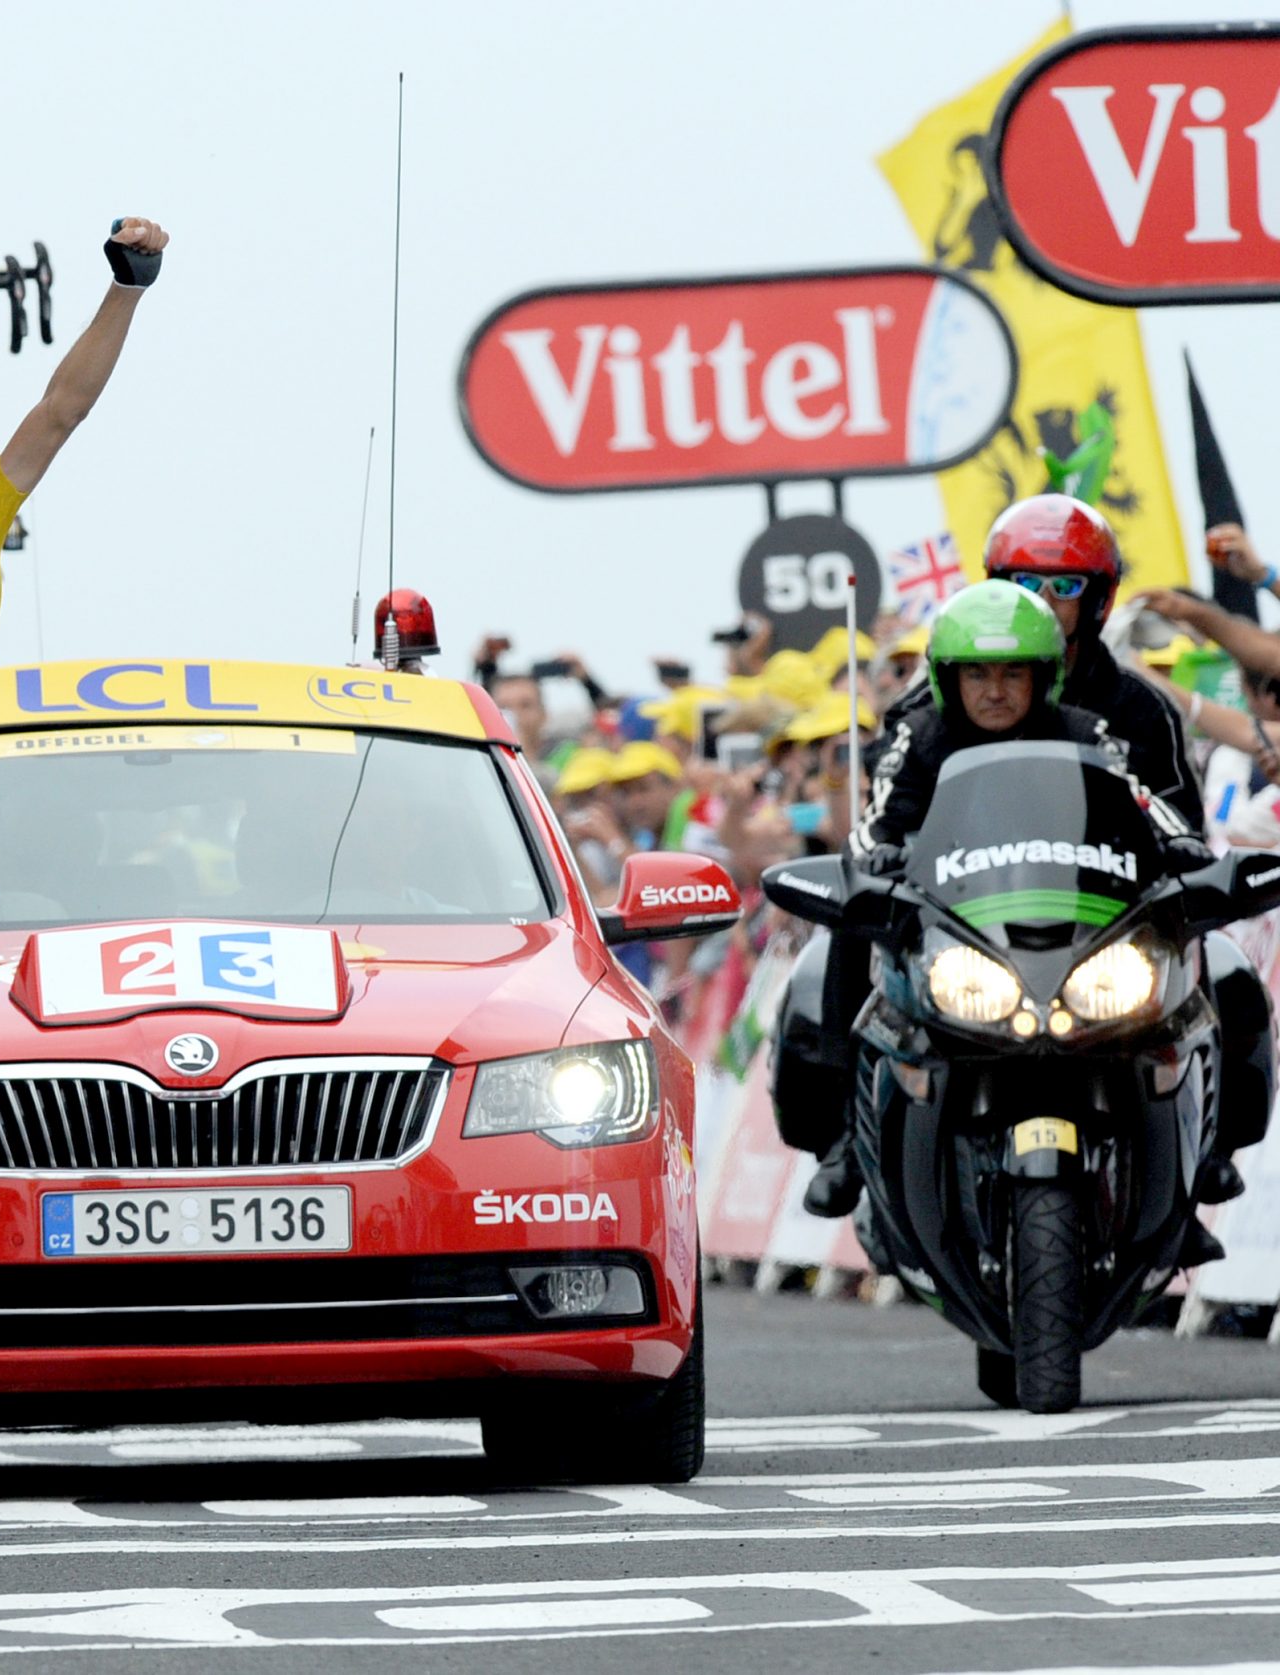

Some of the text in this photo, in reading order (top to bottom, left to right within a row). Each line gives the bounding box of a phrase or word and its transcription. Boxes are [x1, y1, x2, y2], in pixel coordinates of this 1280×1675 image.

[501, 306, 888, 457] Vittel
[763, 551, 854, 611] 50
[15, 664, 259, 713] LCL
[316, 678, 412, 704] LCL
[15, 733, 301, 750] OFFICIEL 1
[936, 839, 1138, 886] Kawasaki
[639, 883, 731, 908] ŠKODA
[118, 939, 275, 991] 2 3
[1030, 1128, 1057, 1143] 15
[86, 1196, 326, 1246] 3SC 5136
[473, 1188, 619, 1226] ŠKODA
[48, 1233, 72, 1250] CZ
